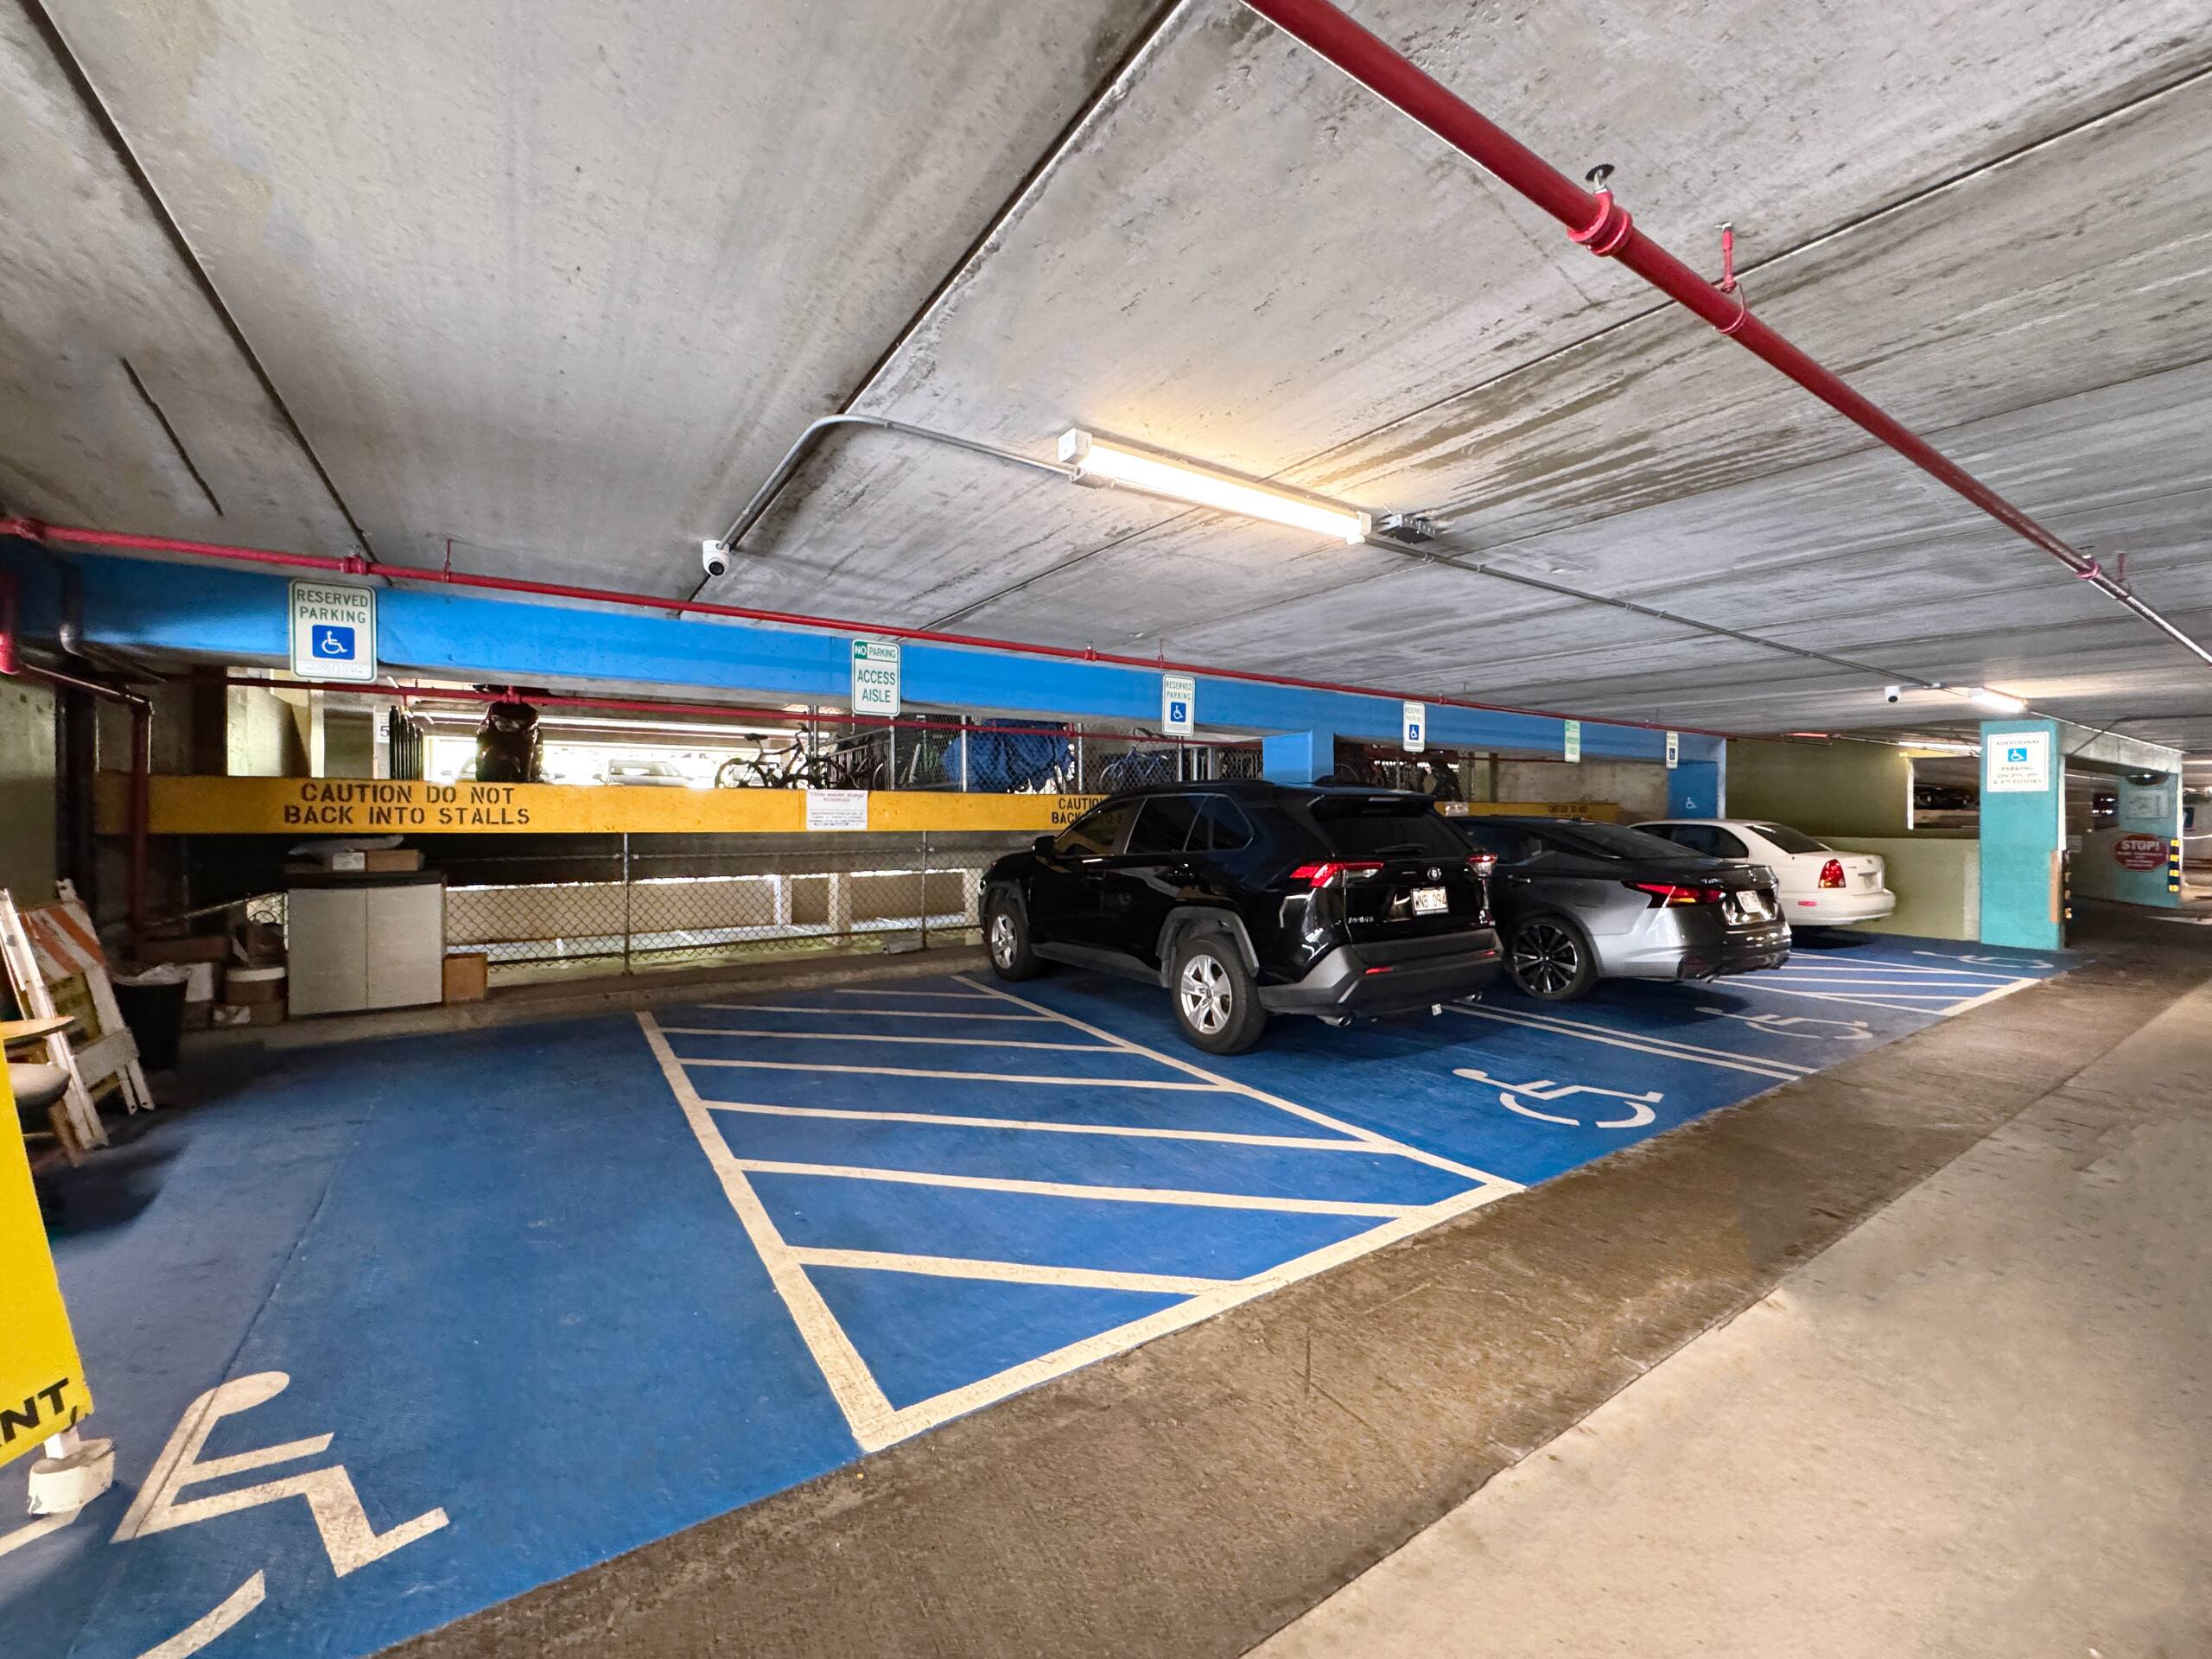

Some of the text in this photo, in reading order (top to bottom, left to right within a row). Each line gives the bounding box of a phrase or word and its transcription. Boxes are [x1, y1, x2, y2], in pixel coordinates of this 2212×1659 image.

[296, 589, 369, 607] RESERVED
[300, 607, 366, 624] PARKING
[855, 645, 896, 658] NO PARKING
[857, 669, 896, 685] ACCESS
[1166, 680, 1192, 690] RESERVED
[861, 688, 892, 703] AISLE
[1166, 690, 1192, 701] PARKING
[302, 783, 515, 804] CAUTION DO NOT
[1058, 798, 1105, 810] CAUTIO
[283, 805, 530, 825] BACK INTO STALLS
[2121, 840, 2160, 851] STOP!
[0, 1376, 69, 1445] NT
